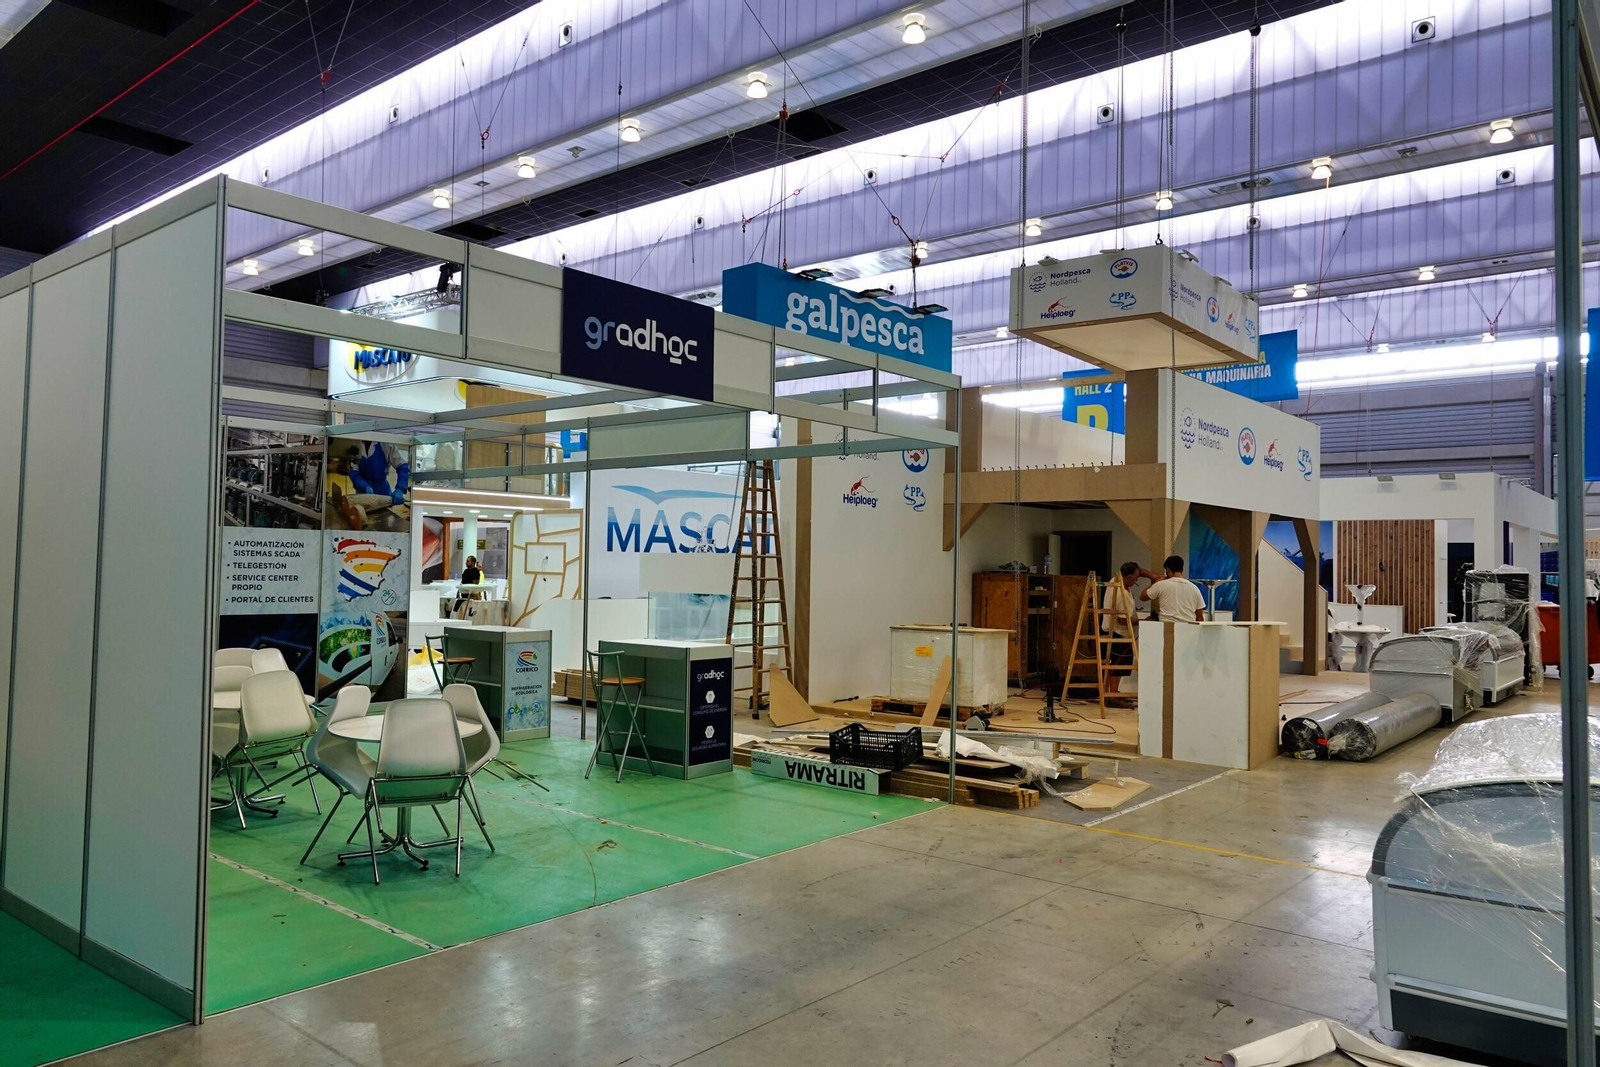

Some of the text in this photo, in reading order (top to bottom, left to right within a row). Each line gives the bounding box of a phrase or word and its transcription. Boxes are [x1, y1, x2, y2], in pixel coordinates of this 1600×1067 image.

[1051, 269, 1091, 279] Nordpesca
[1041, 310, 1074, 319] Heiploeg
[786, 292, 925, 355] galpesca
[584, 316, 697, 365] gradhoc
[1206, 365, 1271, 383] MAQUINARIA
[1198, 418, 1229, 438] Nordpesca
[1264, 455, 1284, 472] Heiploeg
[843, 492, 877, 508] Heiploeg
[234, 540, 304, 548] AUTOMATIZACIÓN
[697, 670, 724, 682] gradhoc
[785, 760, 865, 790] RITRAMA
